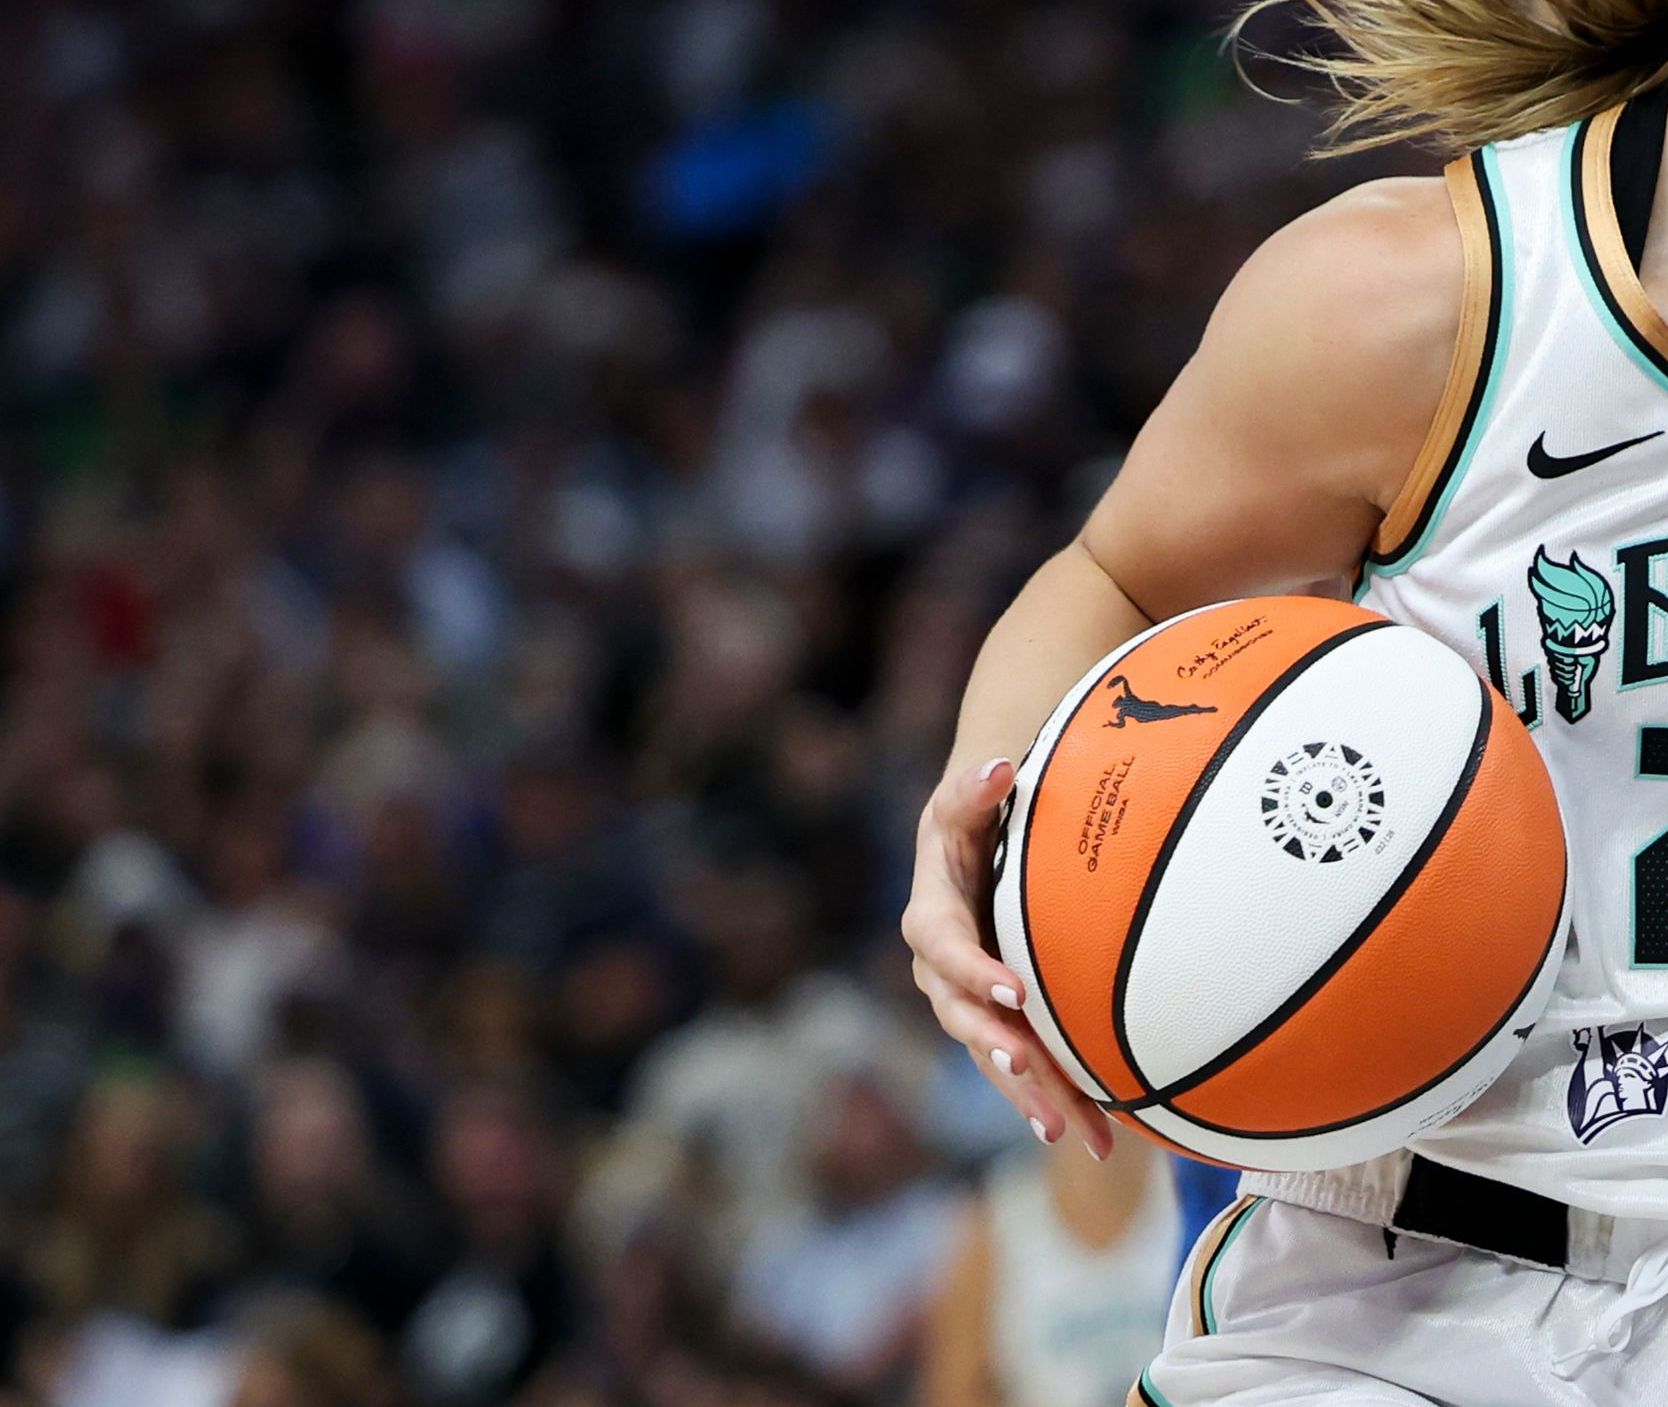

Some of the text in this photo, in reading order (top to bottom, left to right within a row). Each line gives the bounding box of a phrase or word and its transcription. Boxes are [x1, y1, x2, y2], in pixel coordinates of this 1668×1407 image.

[1079, 764, 1116, 854] OFFICIAL
[1088, 756, 1135, 872] GAME BALL
